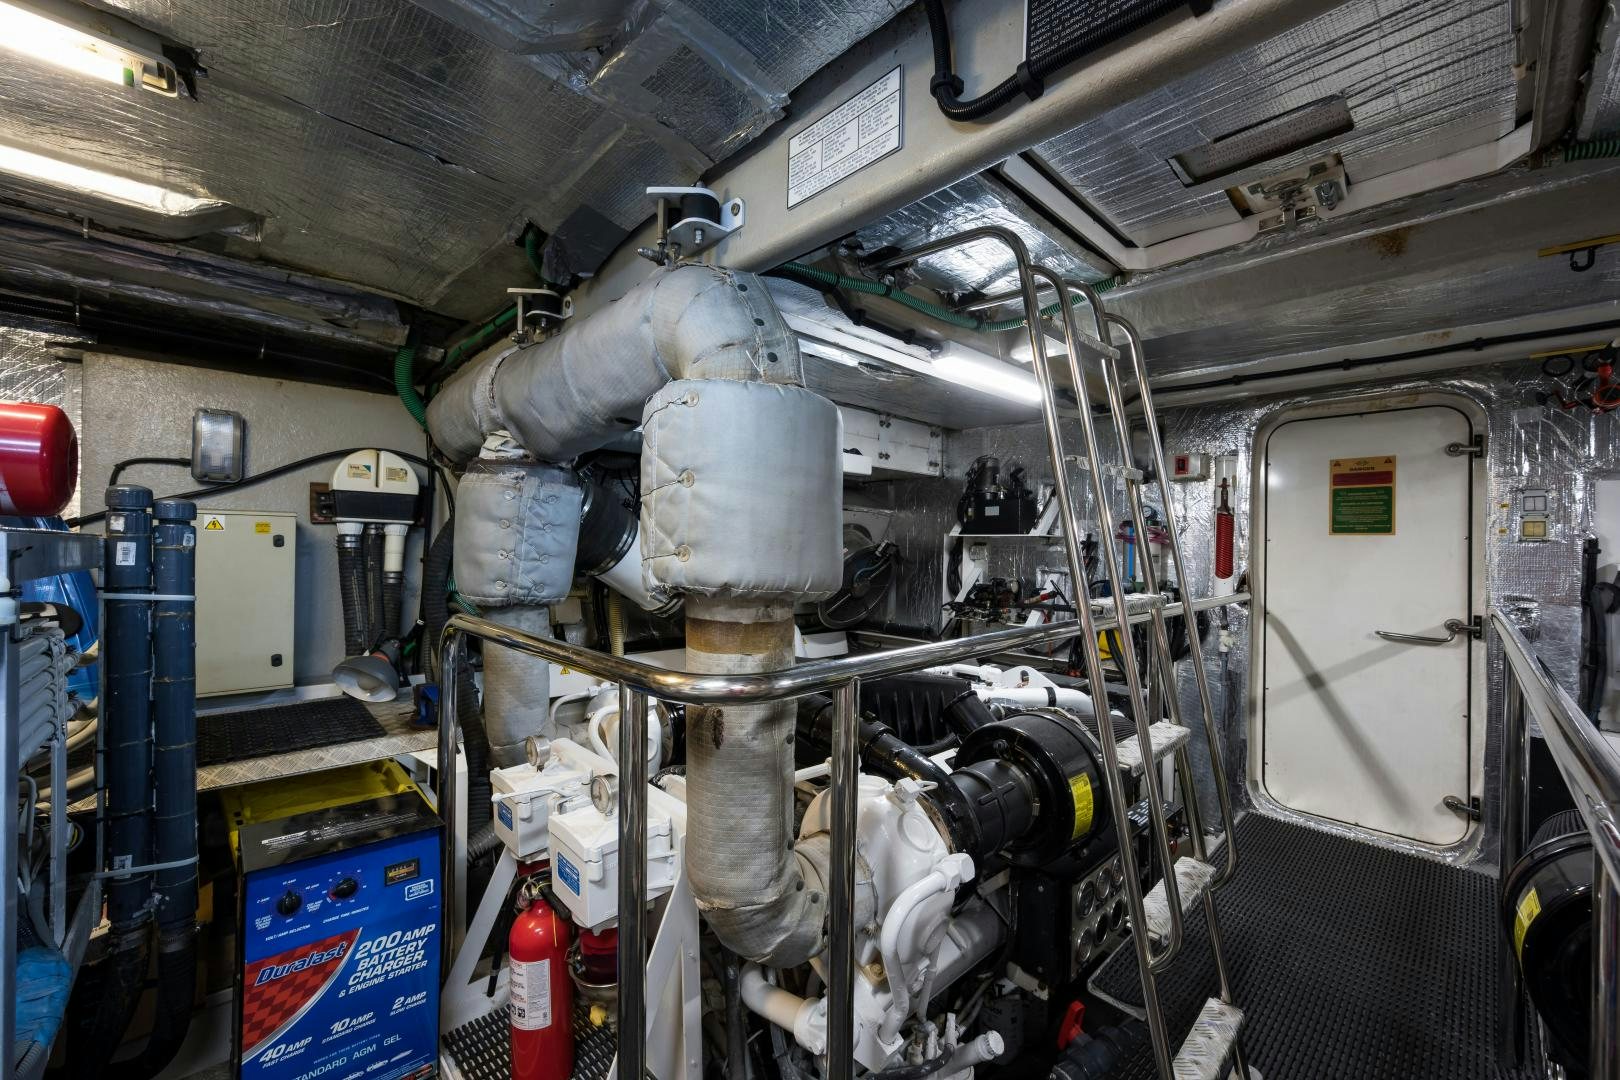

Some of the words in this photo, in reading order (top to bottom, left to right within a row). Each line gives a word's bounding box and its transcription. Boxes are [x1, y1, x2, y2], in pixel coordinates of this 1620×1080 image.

[1054, 25, 1062, 33] THE
[1065, 12, 1086, 26] SURFACE
[1061, 17, 1092, 37] SUBSTANTIAL
[1095, 7, 1107, 17] CIVIL
[1073, 2, 1089, 14] WATER
[1060, 27, 1088, 45] INCLUDING
[1091, 17, 1106, 28] FINES
[1108, 9, 1120, 19] AND
[355, 930, 402, 960] 200
[401, 923, 436, 943] AMP
[357, 938, 428, 972] BATTERY
[254, 941, 348, 987] Duralast
[338, 989, 346, 998] &
[348, 974, 387, 995] ENGINE
[387, 960, 428, 980] STARTER
[348, 949, 425, 985] CHARGER
[392, 996, 405, 1010] 2
[404, 991, 427, 1005] AMP
[321, 1027, 354, 1044] STANDARD
[354, 1017, 377, 1031] CHARGE
[330, 1017, 351, 1034] 10
[349, 1011, 374, 1027] AMP
[258, 1043, 287, 1063] 40
[285, 1036, 313, 1054] AMP
[262, 1058, 279, 1069] FAST
[280, 1047, 305, 1061] CHARGE
[292, 1056, 347, 1080] TANDARD
[352, 1043, 377, 1060] AGM
[383, 1033, 402, 1046] GEL
